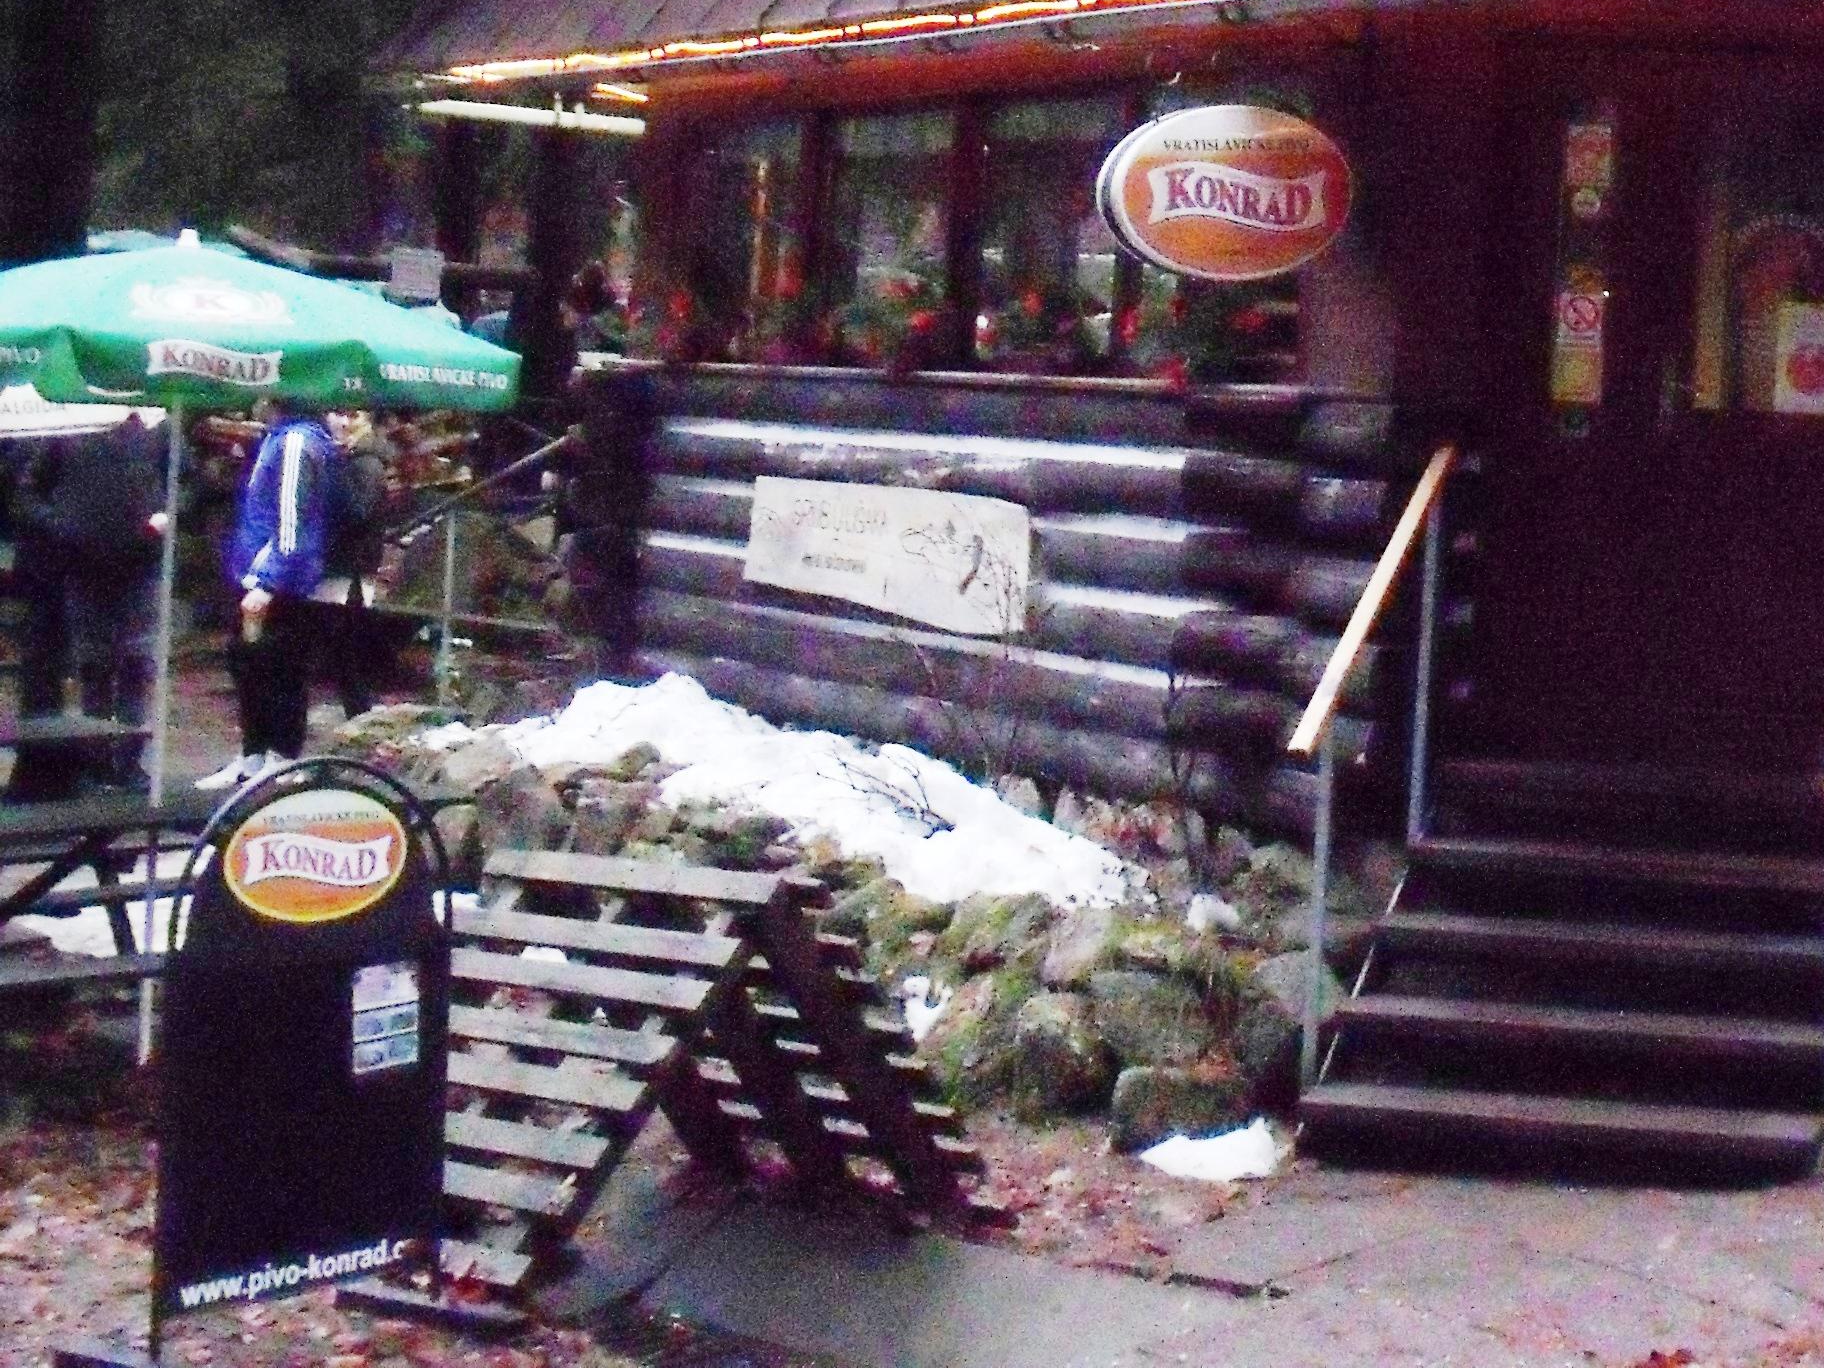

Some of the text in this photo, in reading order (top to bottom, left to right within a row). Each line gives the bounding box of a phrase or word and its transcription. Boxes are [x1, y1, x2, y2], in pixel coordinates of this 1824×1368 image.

[1165, 167, 1313, 226] KONRAD
[163, 343, 272, 382] KONRAD
[260, 839, 377, 881] KONRAD
[180, 1237, 416, 1308] www.pivo-konrad.c
